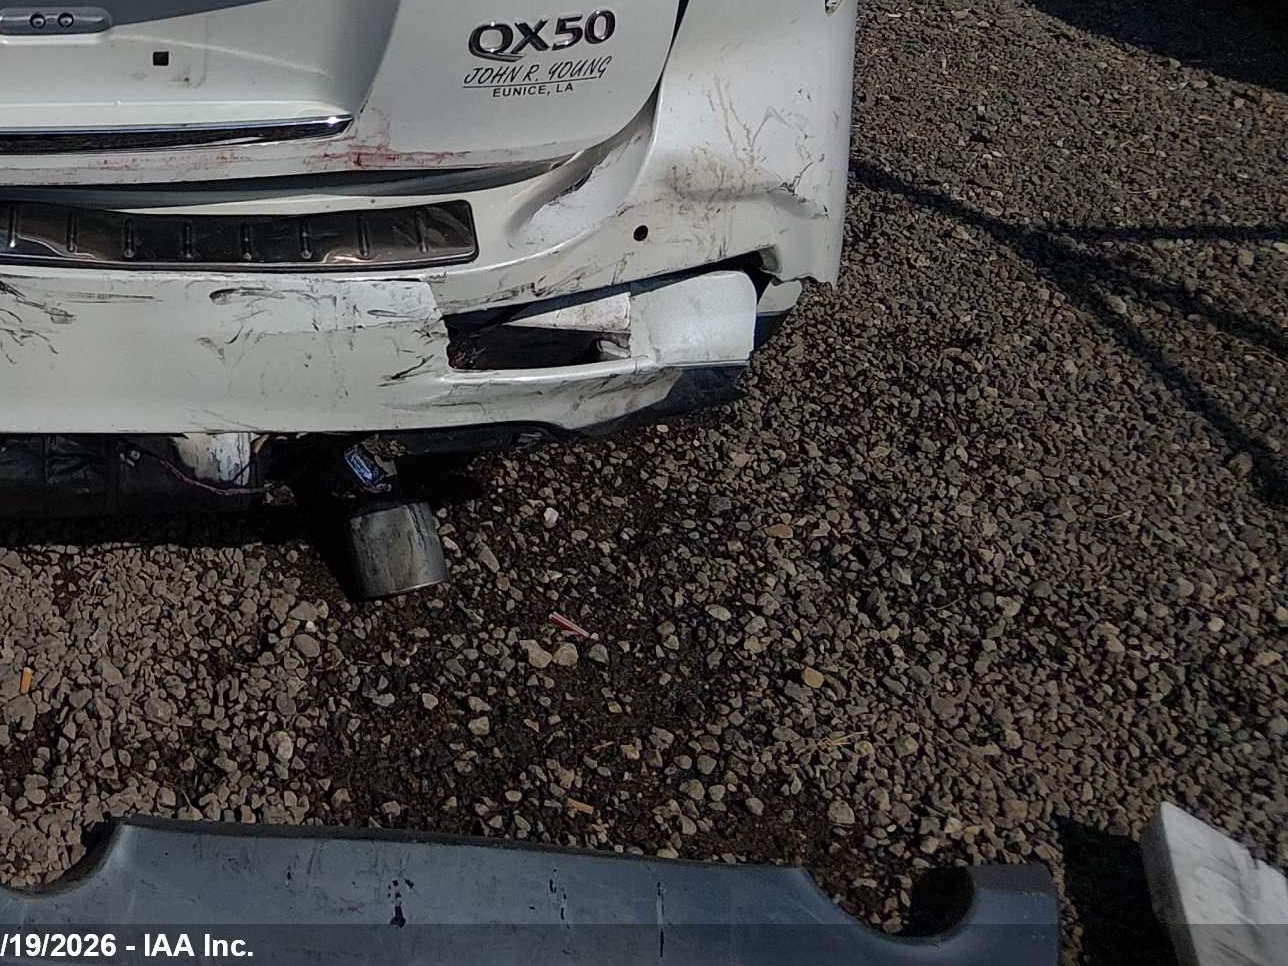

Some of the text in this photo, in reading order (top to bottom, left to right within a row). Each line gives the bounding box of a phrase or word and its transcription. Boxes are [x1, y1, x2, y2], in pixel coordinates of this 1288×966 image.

[468, 10, 616, 63] QX50
[464, 55, 613, 84] JOHN R. YOUNG
[492, 81, 574, 98] EUNICE, LA
